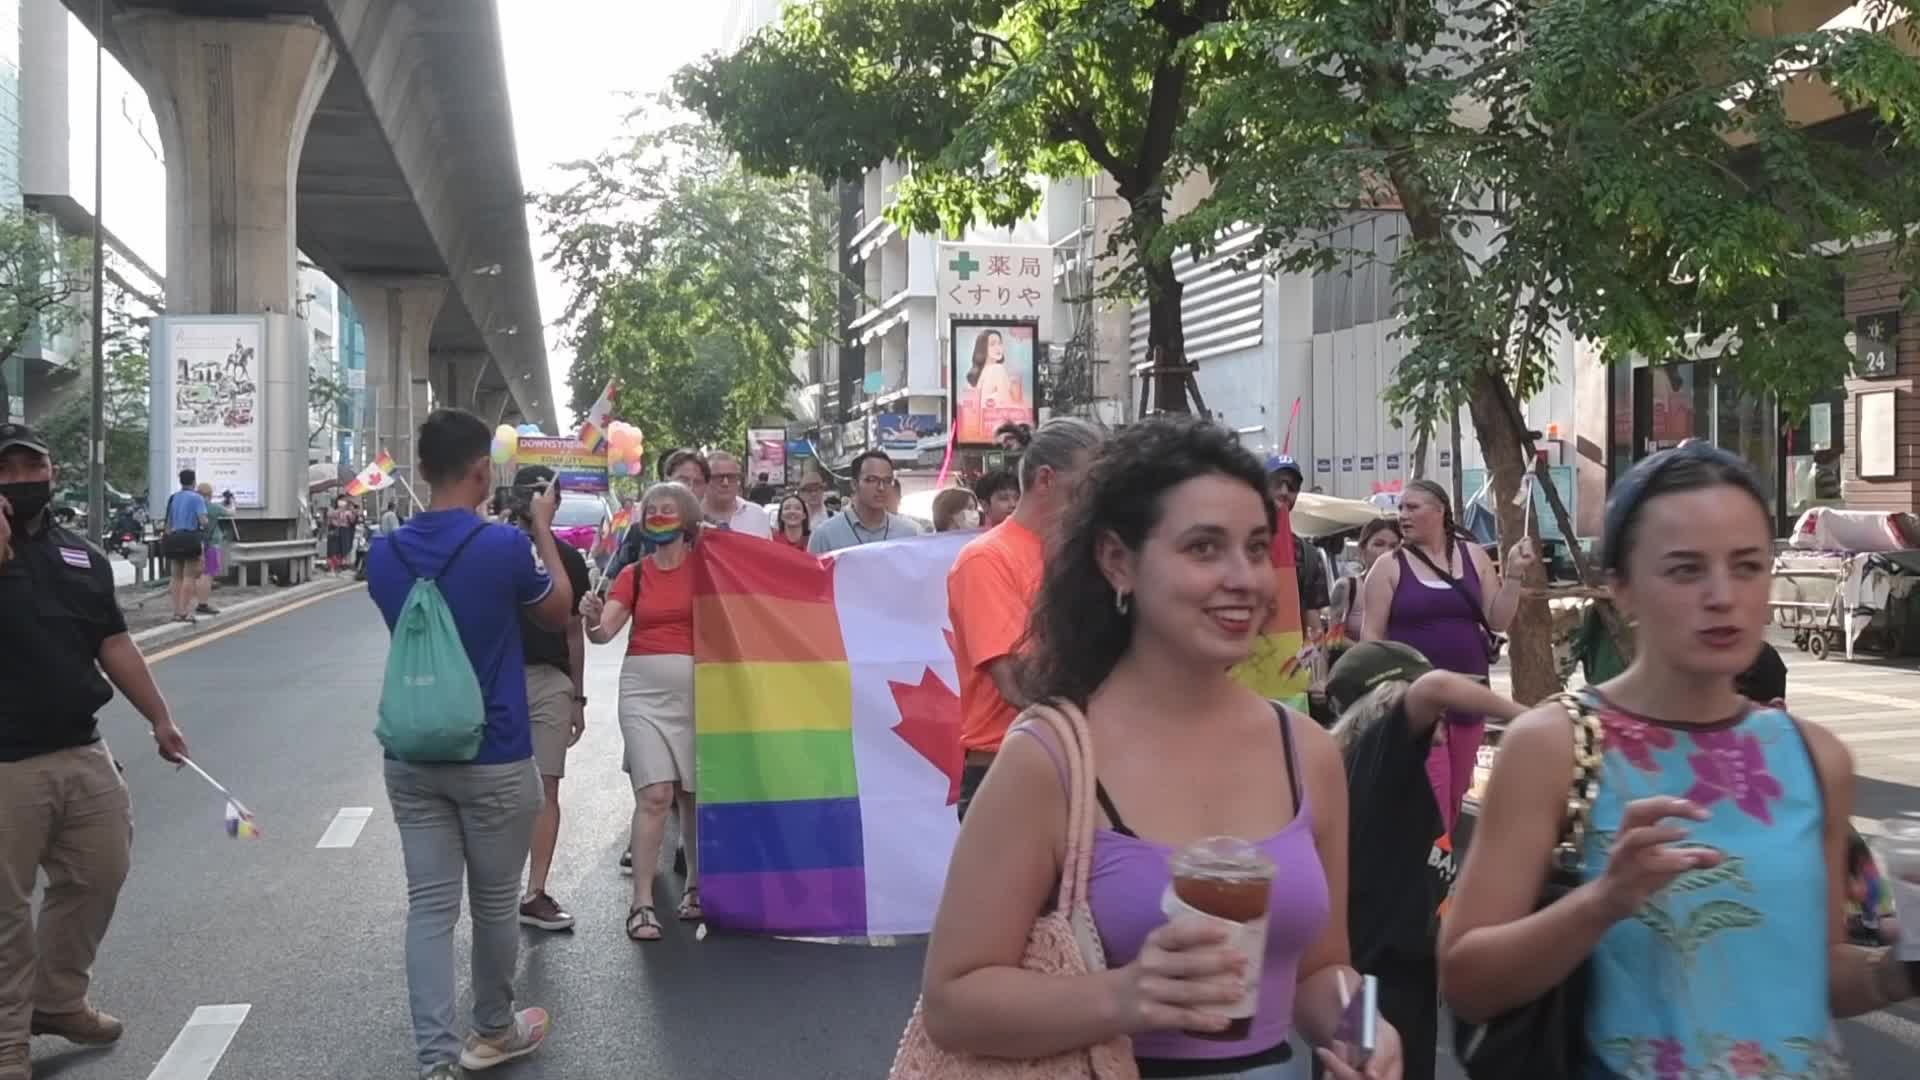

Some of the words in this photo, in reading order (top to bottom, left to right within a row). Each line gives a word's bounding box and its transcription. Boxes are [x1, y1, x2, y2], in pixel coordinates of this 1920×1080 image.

[986, 255, 1040, 277] 薬局
[950, 284, 1040, 307] くすりや
[1866, 351, 1885, 371] 24
